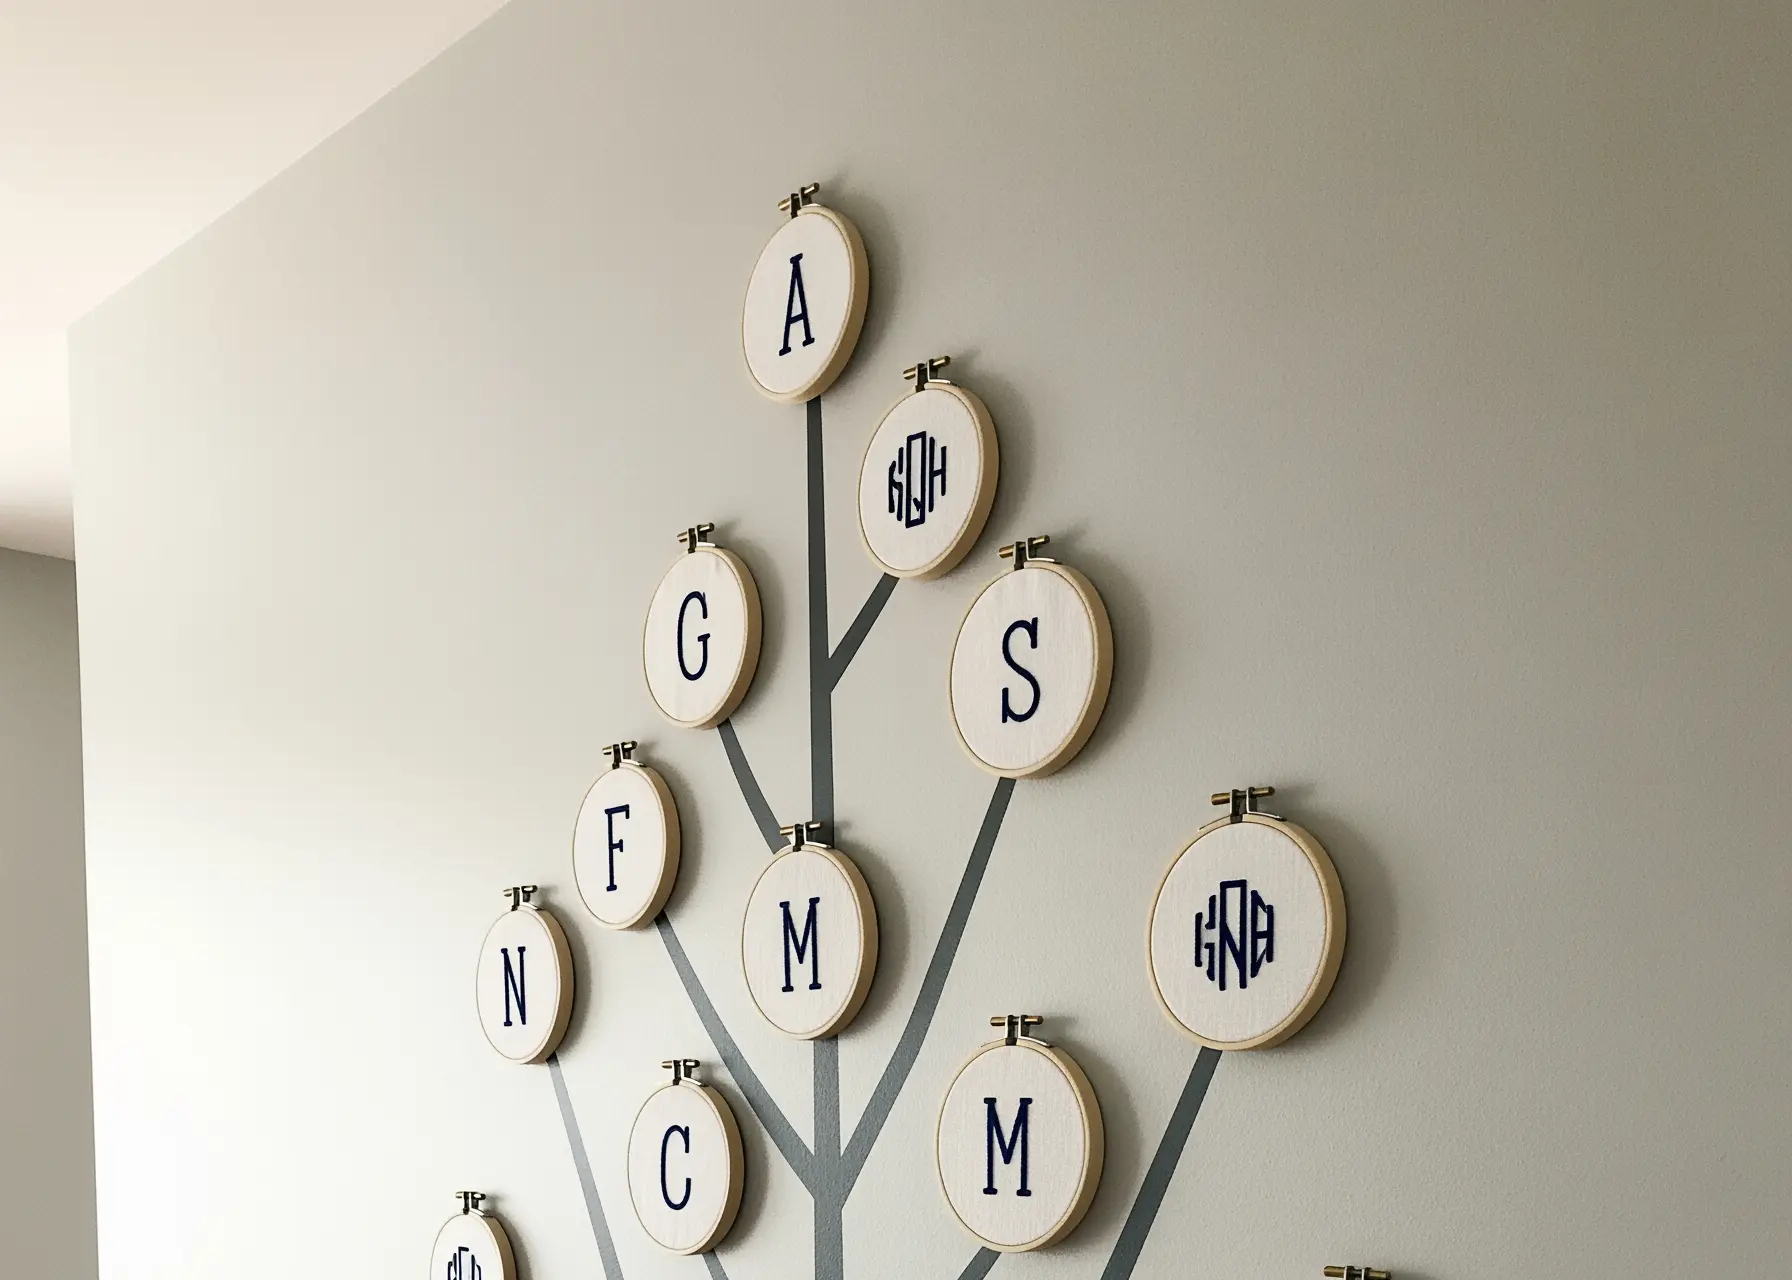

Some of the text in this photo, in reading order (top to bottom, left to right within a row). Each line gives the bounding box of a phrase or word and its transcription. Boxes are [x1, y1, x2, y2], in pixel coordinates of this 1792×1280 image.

[778, 252, 816, 357] A
[676, 590, 711, 682] G
[1001, 616, 1041, 724] S
[604, 803, 630, 892] F
[500, 946, 527, 1027] N
[779, 896, 822, 993] M
[660, 1124, 692, 1211] C
[982, 1097, 1034, 1197] M
